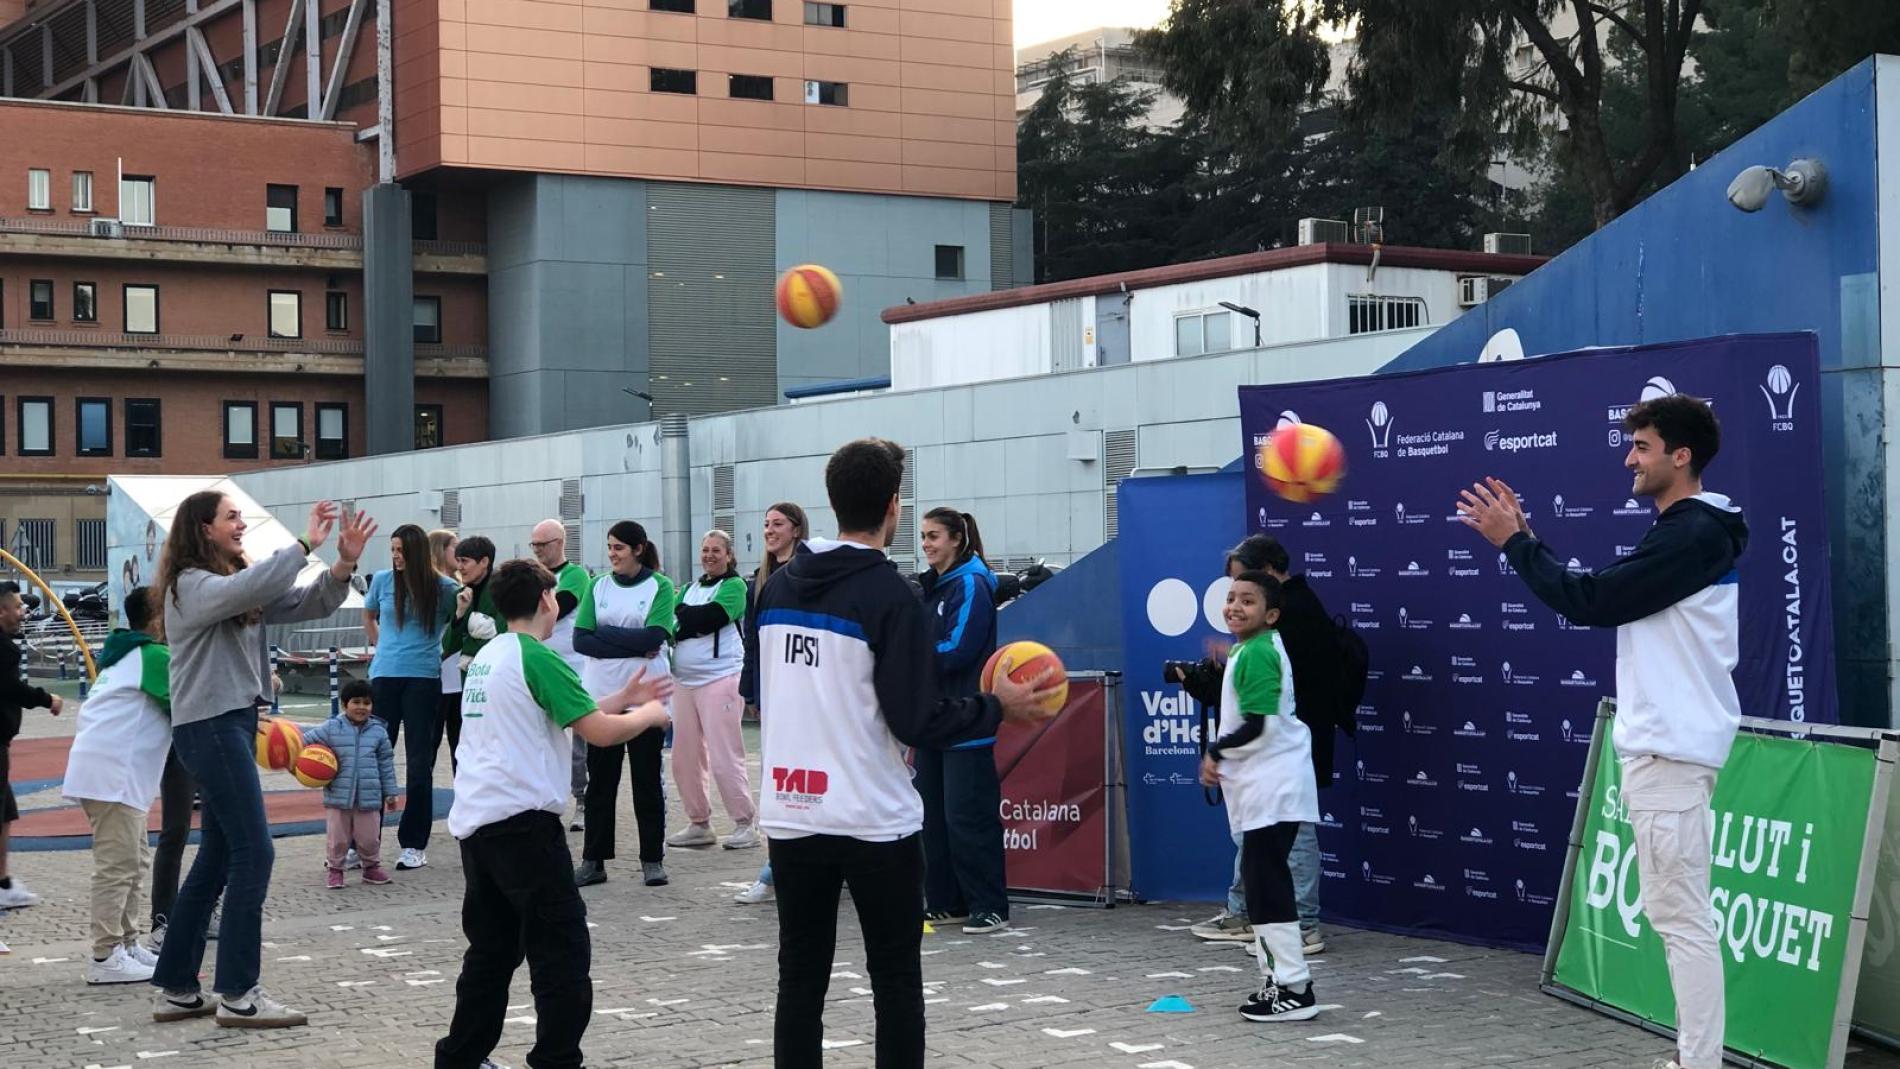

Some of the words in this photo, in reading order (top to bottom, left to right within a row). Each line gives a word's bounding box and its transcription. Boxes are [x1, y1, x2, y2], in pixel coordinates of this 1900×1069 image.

[1497, 389, 1534, 401] Generalitat
[1497, 403, 1506, 412] de
[1507, 400, 1541, 412] Catalunya
[1772, 422, 1794, 431] FCBQ
[1397, 432, 1431, 445] Federació
[1432, 430, 1464, 441] Catalana
[1499, 431, 1558, 453] esportcat
[1397, 448, 1406, 457] de
[1407, 444, 1449, 457] Basquetbol
[785, 633, 819, 667] IPSI
[1141, 690, 1194, 716] Vall
[1145, 746, 1196, 755] Barcelona
[773, 767, 829, 795] TAD
[1000, 798, 1081, 821] Catalana
[1710, 809, 1793, 878] LUT
[1796, 822, 1814, 884] i
